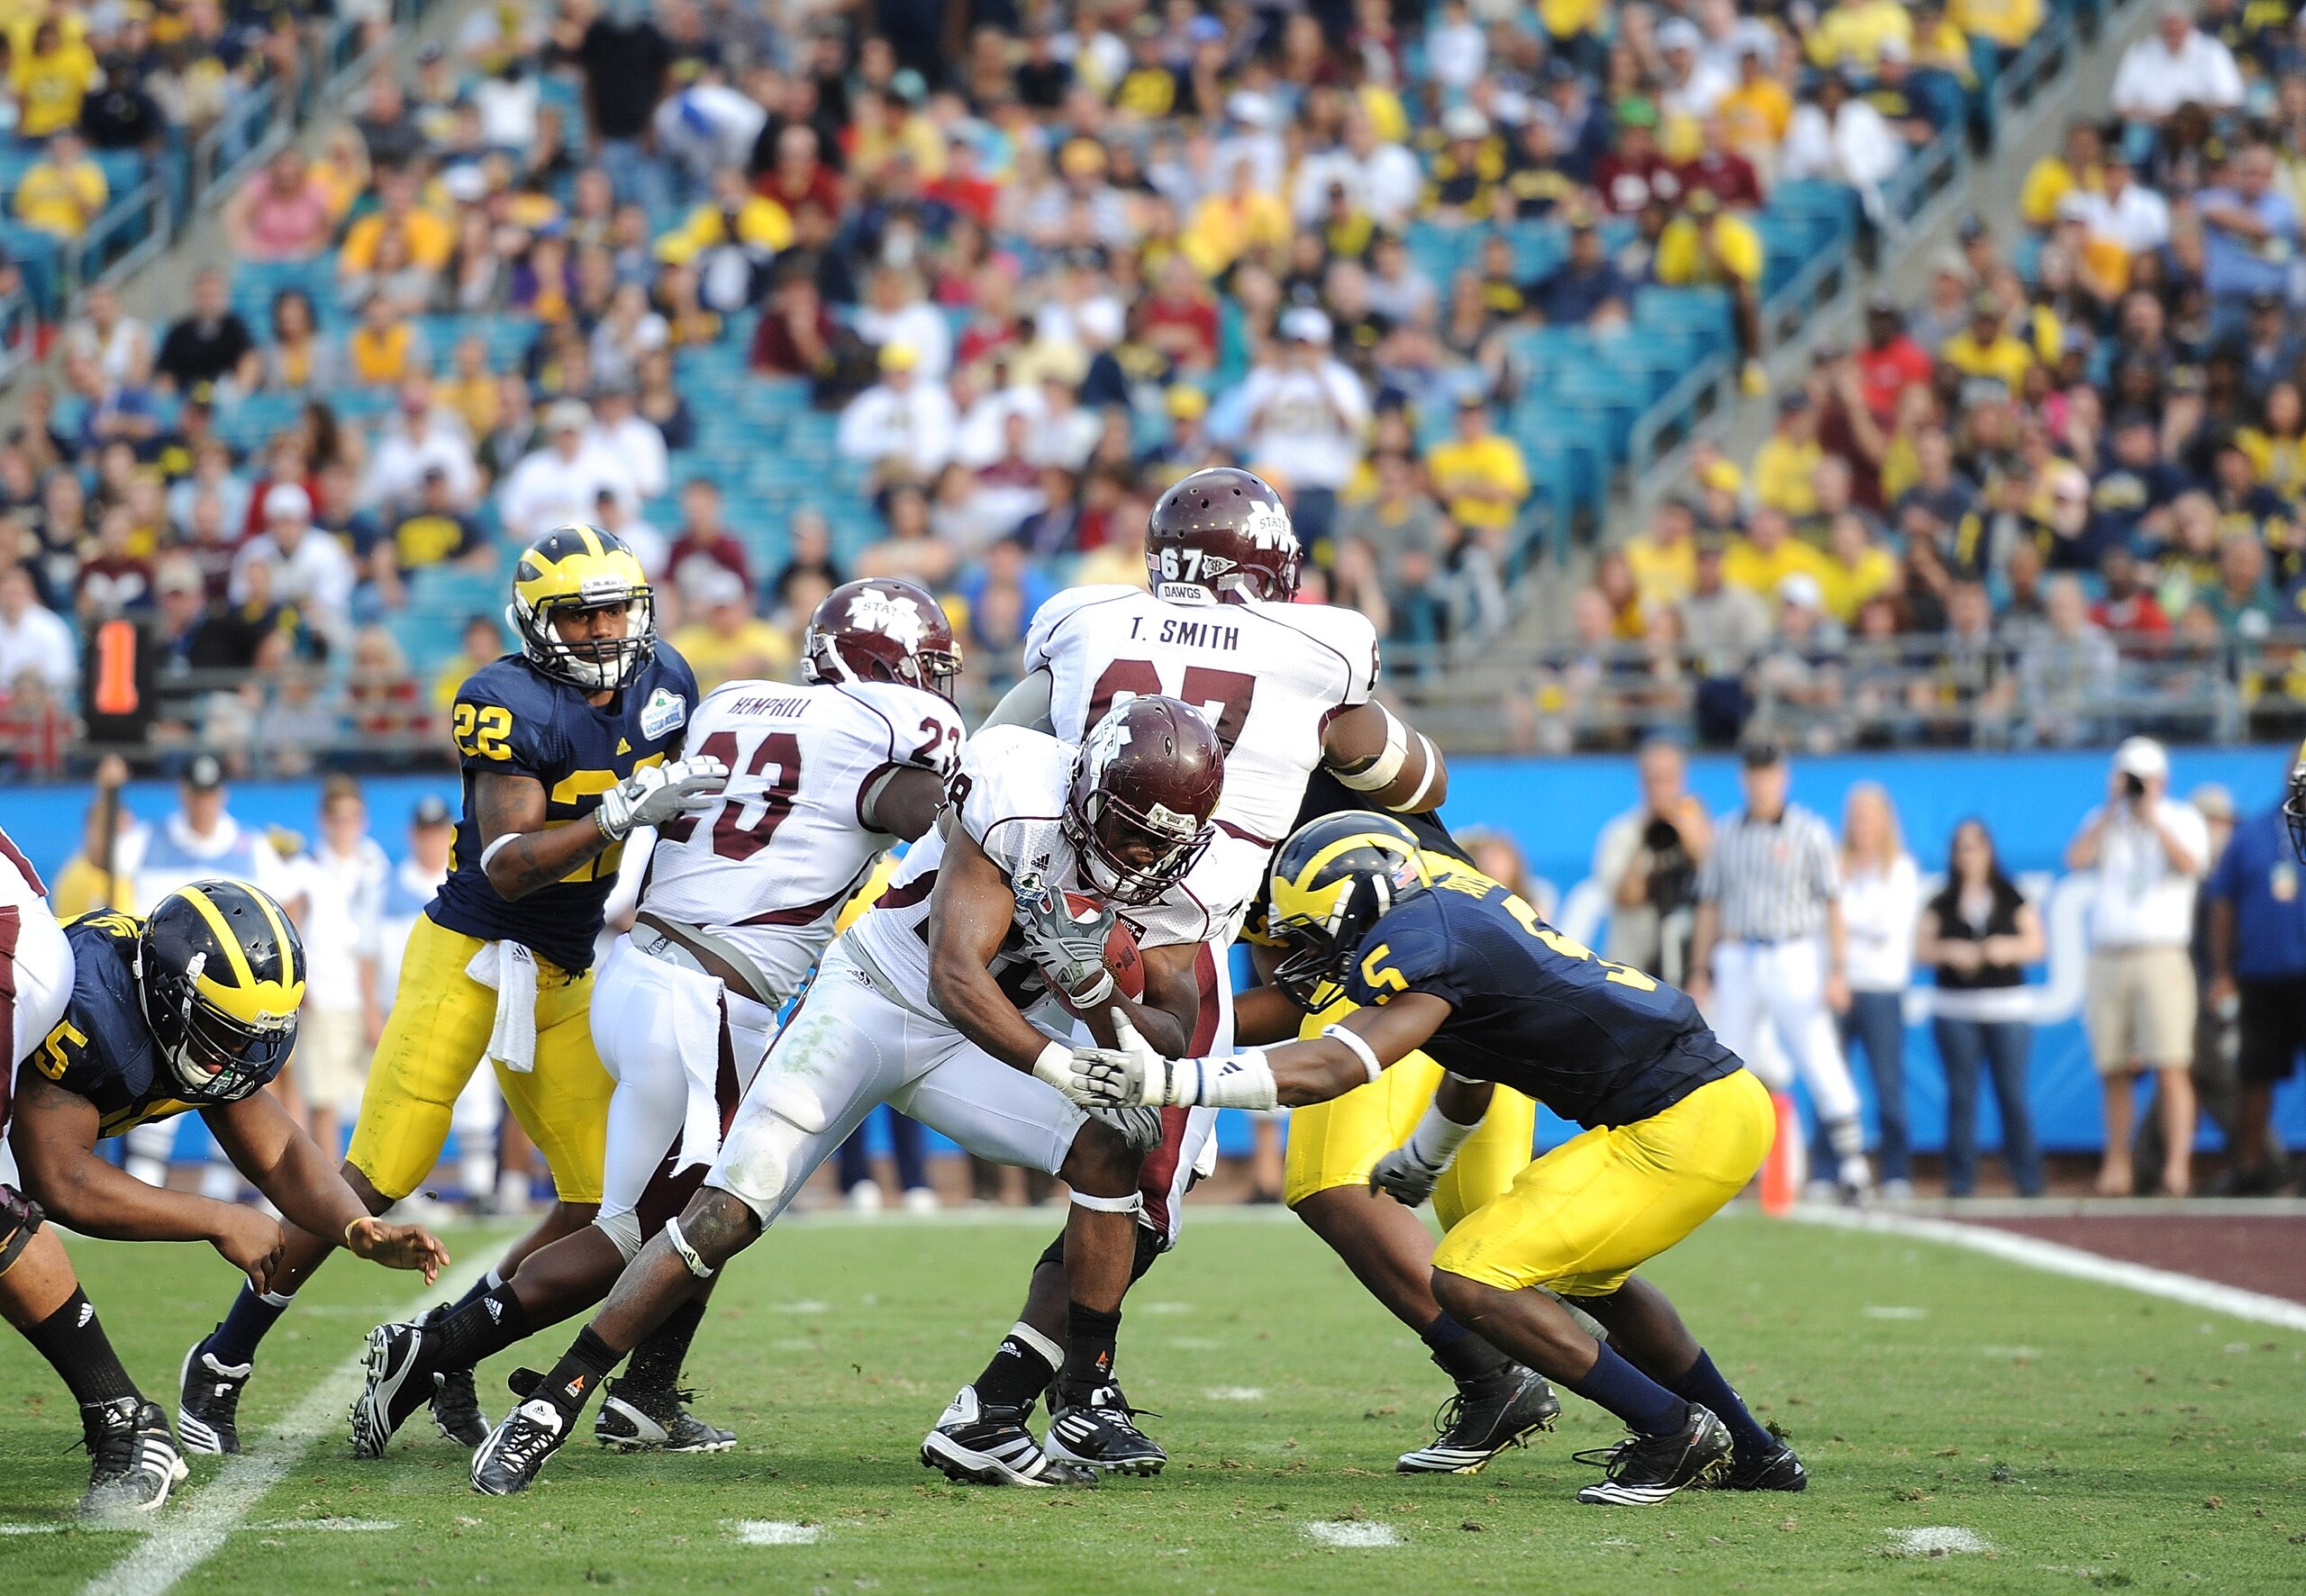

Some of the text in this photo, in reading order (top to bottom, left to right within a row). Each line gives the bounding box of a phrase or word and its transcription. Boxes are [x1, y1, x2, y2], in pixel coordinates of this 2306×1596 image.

[1259, 516, 1287, 530] STATE
[1160, 548, 1203, 581] 67
[1164, 585, 1202, 600] DAWGS
[1130, 616, 1239, 651] T. SMITH
[96, 620, 139, 715] 1
[726, 697, 812, 718] HEMPHILL
[453, 703, 513, 761] 22
[1360, 944, 1410, 1005] 5
[34, 1019, 88, 1080] 5
